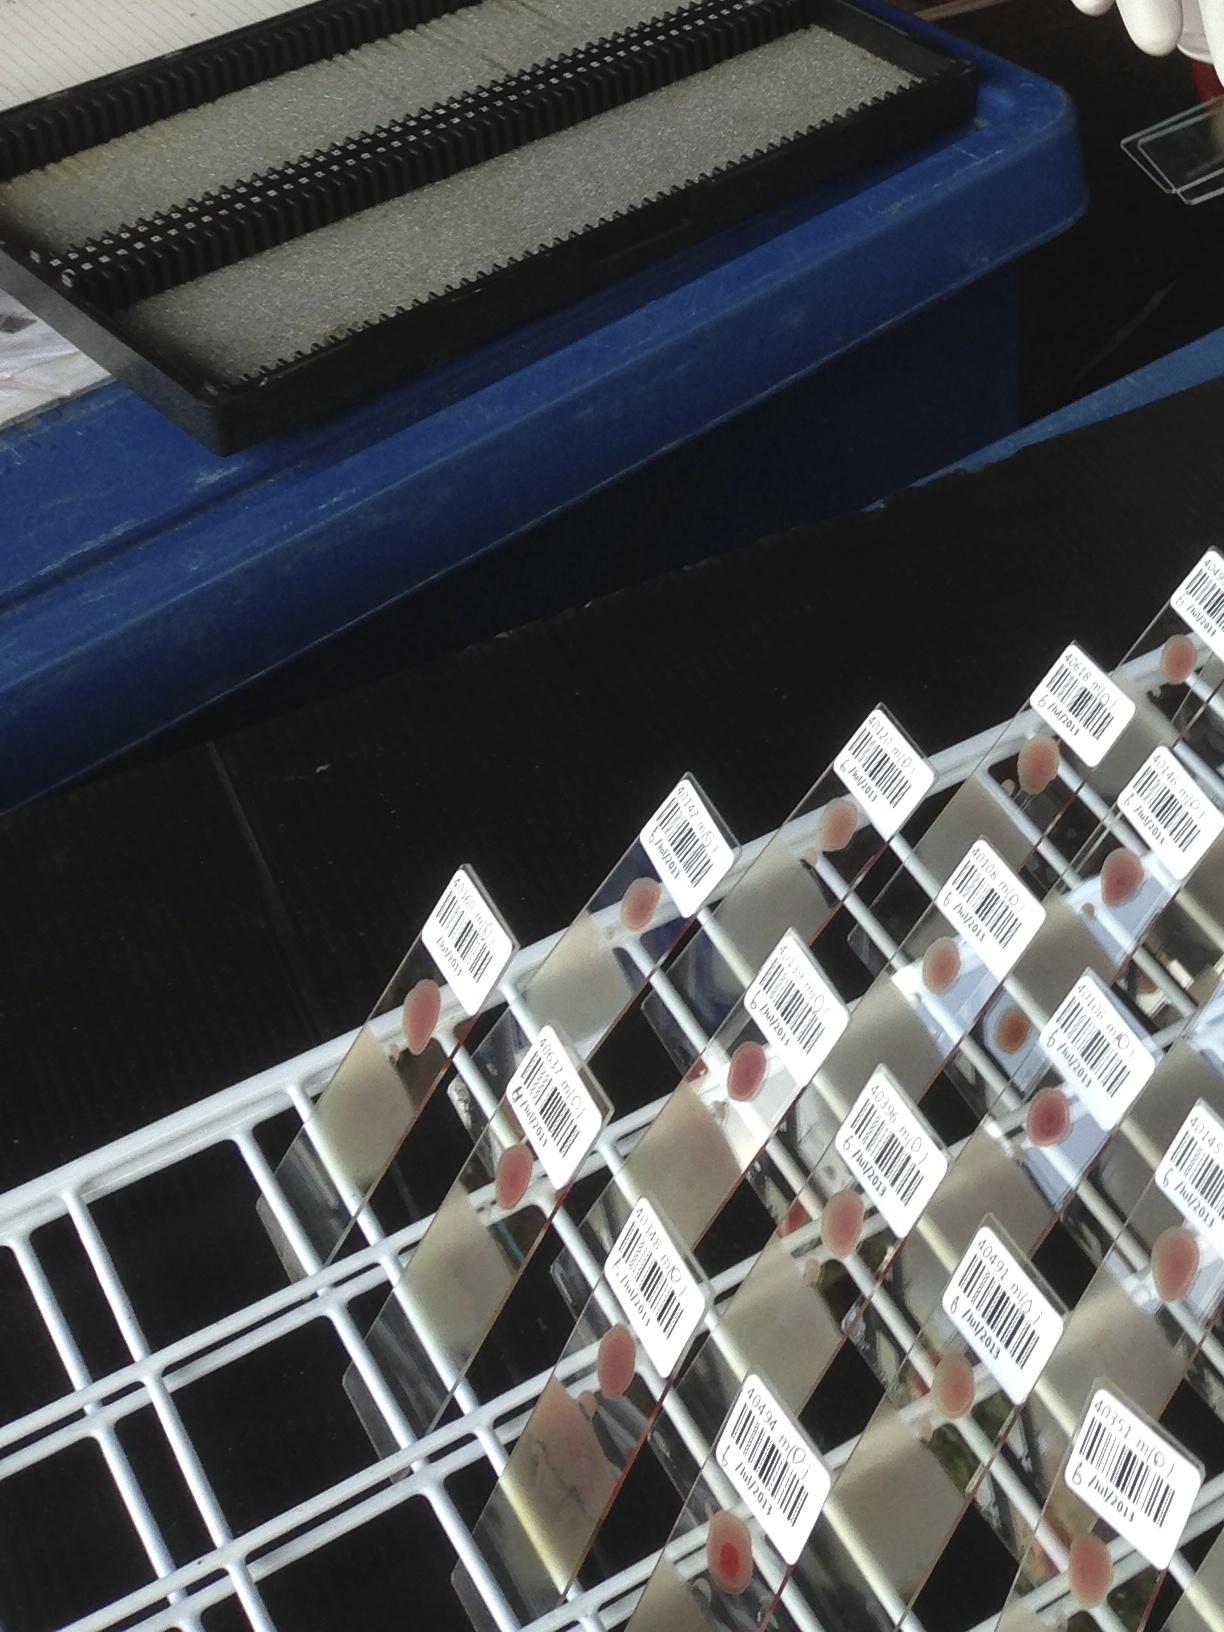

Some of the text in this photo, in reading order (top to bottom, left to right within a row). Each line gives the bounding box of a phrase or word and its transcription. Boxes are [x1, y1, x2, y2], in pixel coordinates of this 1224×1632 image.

[868, 717, 892, 745] 40120
[1153, 755, 1178, 785] 40146
[676, 787, 698, 818] 40142
[972, 848, 999, 880] 40108
[1078, 984, 1106, 1020] 40106
[540, 1038, 563, 1074] 40637
[871, 1086, 899, 1123] 40396
[1190, 1117, 1222, 1154] 40145
[978, 1240, 1008, 1281] 40491
[747, 1388, 777, 1431] 40494
[1094, 1400, 1131, 1440] 40351
